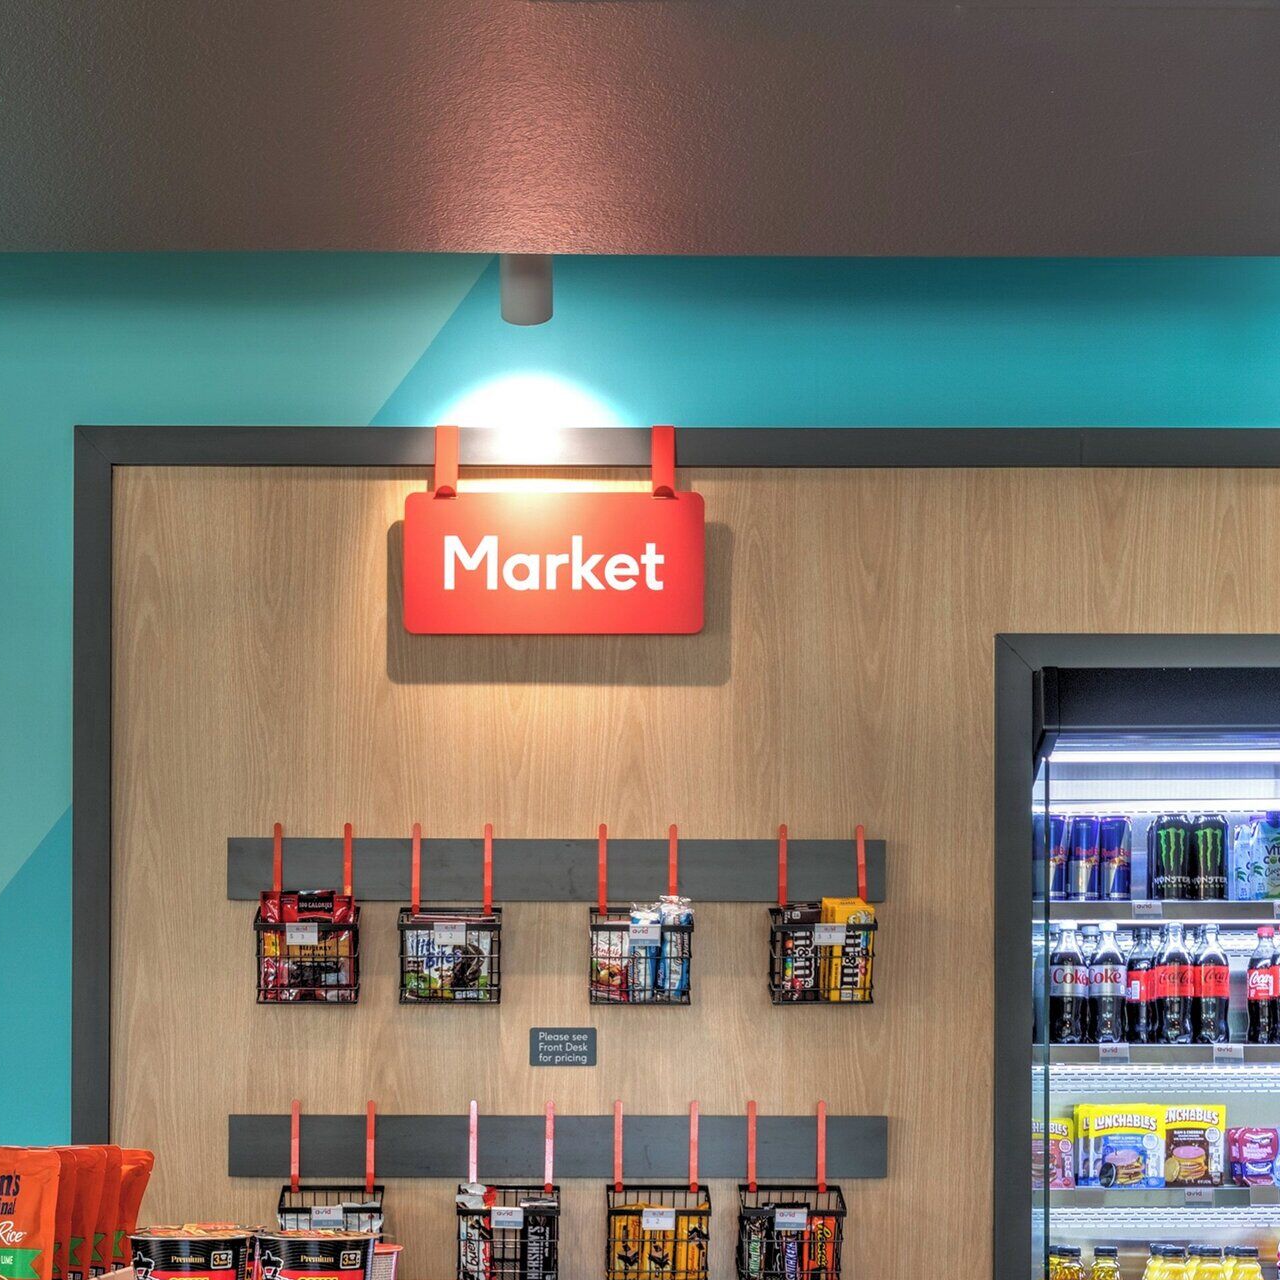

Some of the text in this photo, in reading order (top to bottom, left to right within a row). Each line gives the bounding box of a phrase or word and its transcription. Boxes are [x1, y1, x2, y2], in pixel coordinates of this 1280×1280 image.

[443, 535, 665, 591] Market
[1154, 875, 1190, 885] MONSTER
[1191, 875, 1228, 885] MONSTER
[1053, 968, 1089, 985] Coke
[538, 1032, 569, 1041] Please
[538, 1042, 588, 1052] Front Desk
[538, 1053, 587, 1065] for pricing
[1094, 1113, 1157, 1131] LUNCHABLES
[171, 1255, 205, 1263] Premium
[213, 1254, 220, 1265] 3
[300, 1255, 334, 1263] Premium
[343, 1254, 349, 1265] 3
